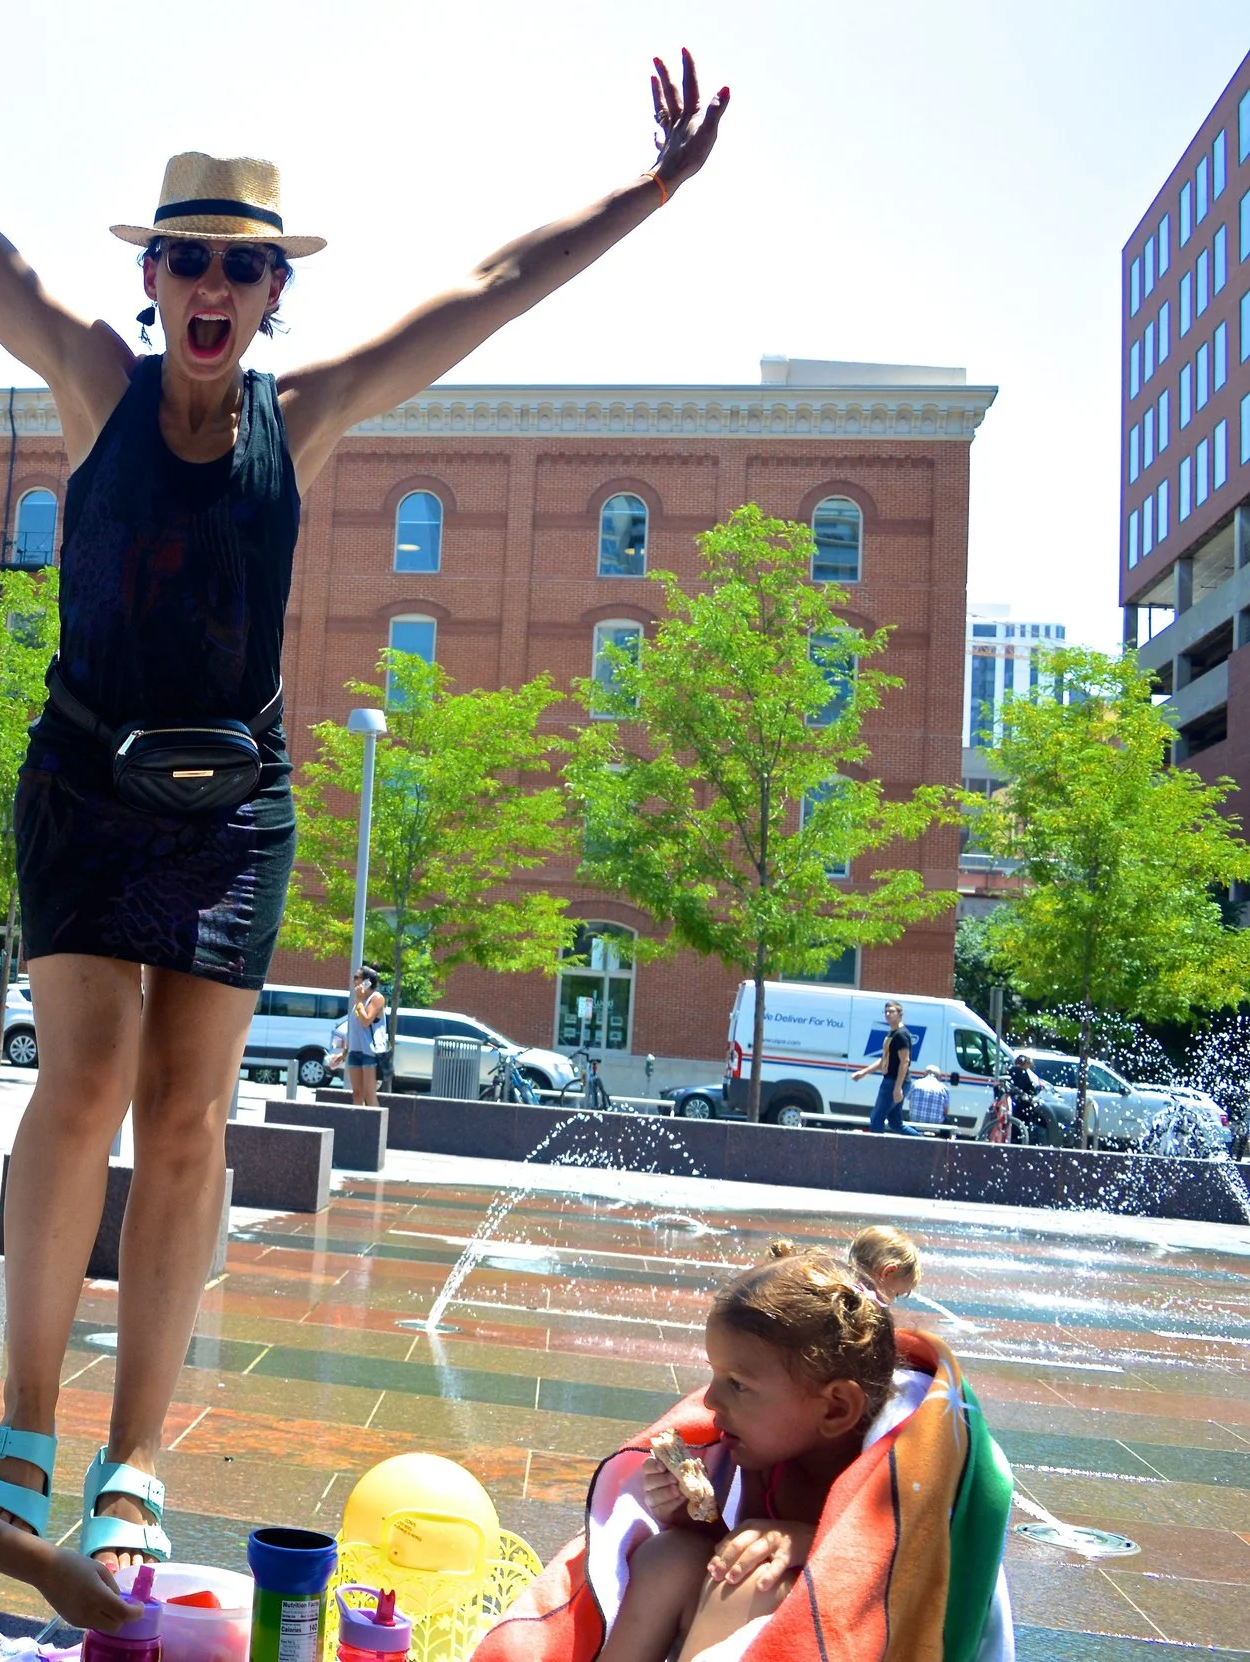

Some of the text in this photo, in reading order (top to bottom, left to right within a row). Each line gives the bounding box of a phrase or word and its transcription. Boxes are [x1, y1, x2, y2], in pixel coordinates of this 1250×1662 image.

[774, 1013, 807, 1024] Deliver
[808, 1016, 825, 1026] For
[826, 1018, 845, 1029] You.
